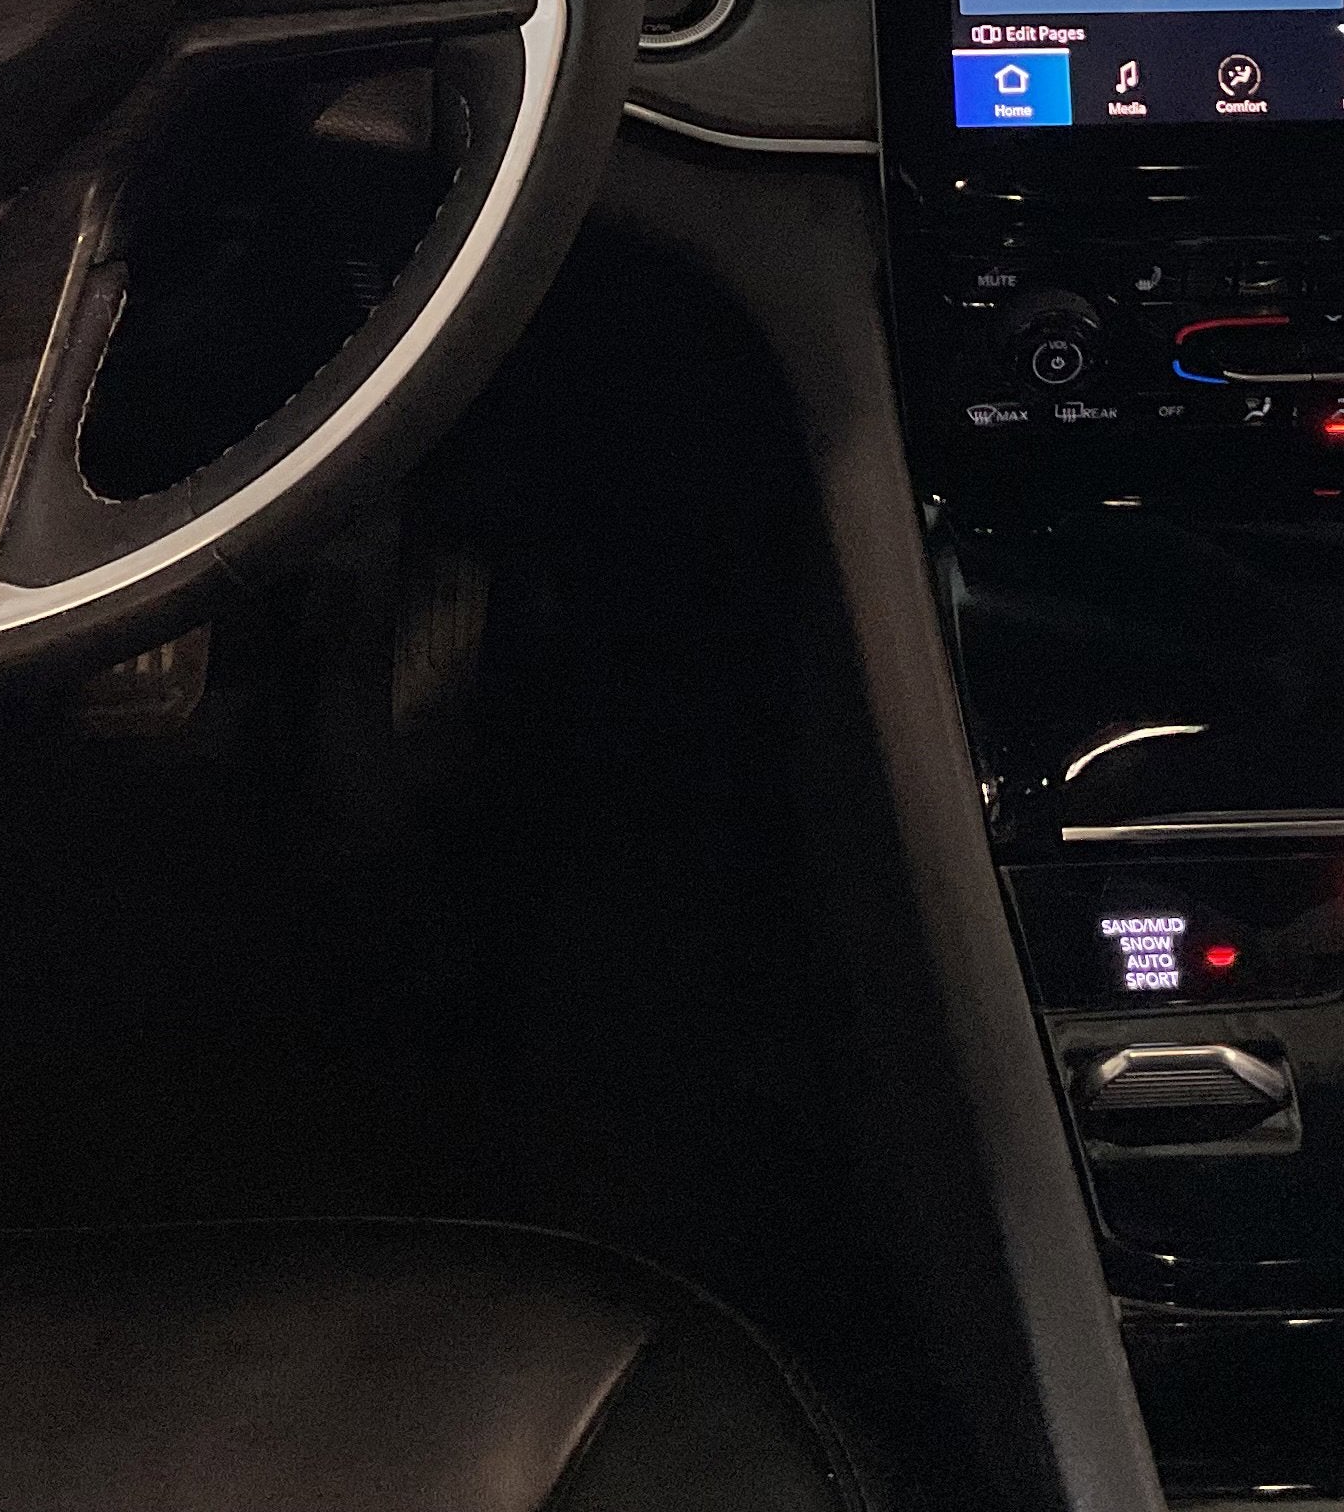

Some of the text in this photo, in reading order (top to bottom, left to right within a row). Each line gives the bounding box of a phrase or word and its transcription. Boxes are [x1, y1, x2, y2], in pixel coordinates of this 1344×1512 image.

[1006, 26, 1085, 44] Edit Pages
[994, 103, 1032, 117] Home
[1108, 101, 1146, 116] Media
[1216, 99, 1267, 113] Comfort
[978, 275, 1016, 287] MUTE
[997, 410, 1028, 422] MAX
[1083, 407, 1118, 419] REAR
[1159, 405, 1184, 417] OFF
[1101, 918, 1184, 934] SAND/MUD
[1120, 936, 1171, 952] SNOW
[1127, 953, 1173, 969] AUTO
[1125, 971, 1179, 990] SPORT
